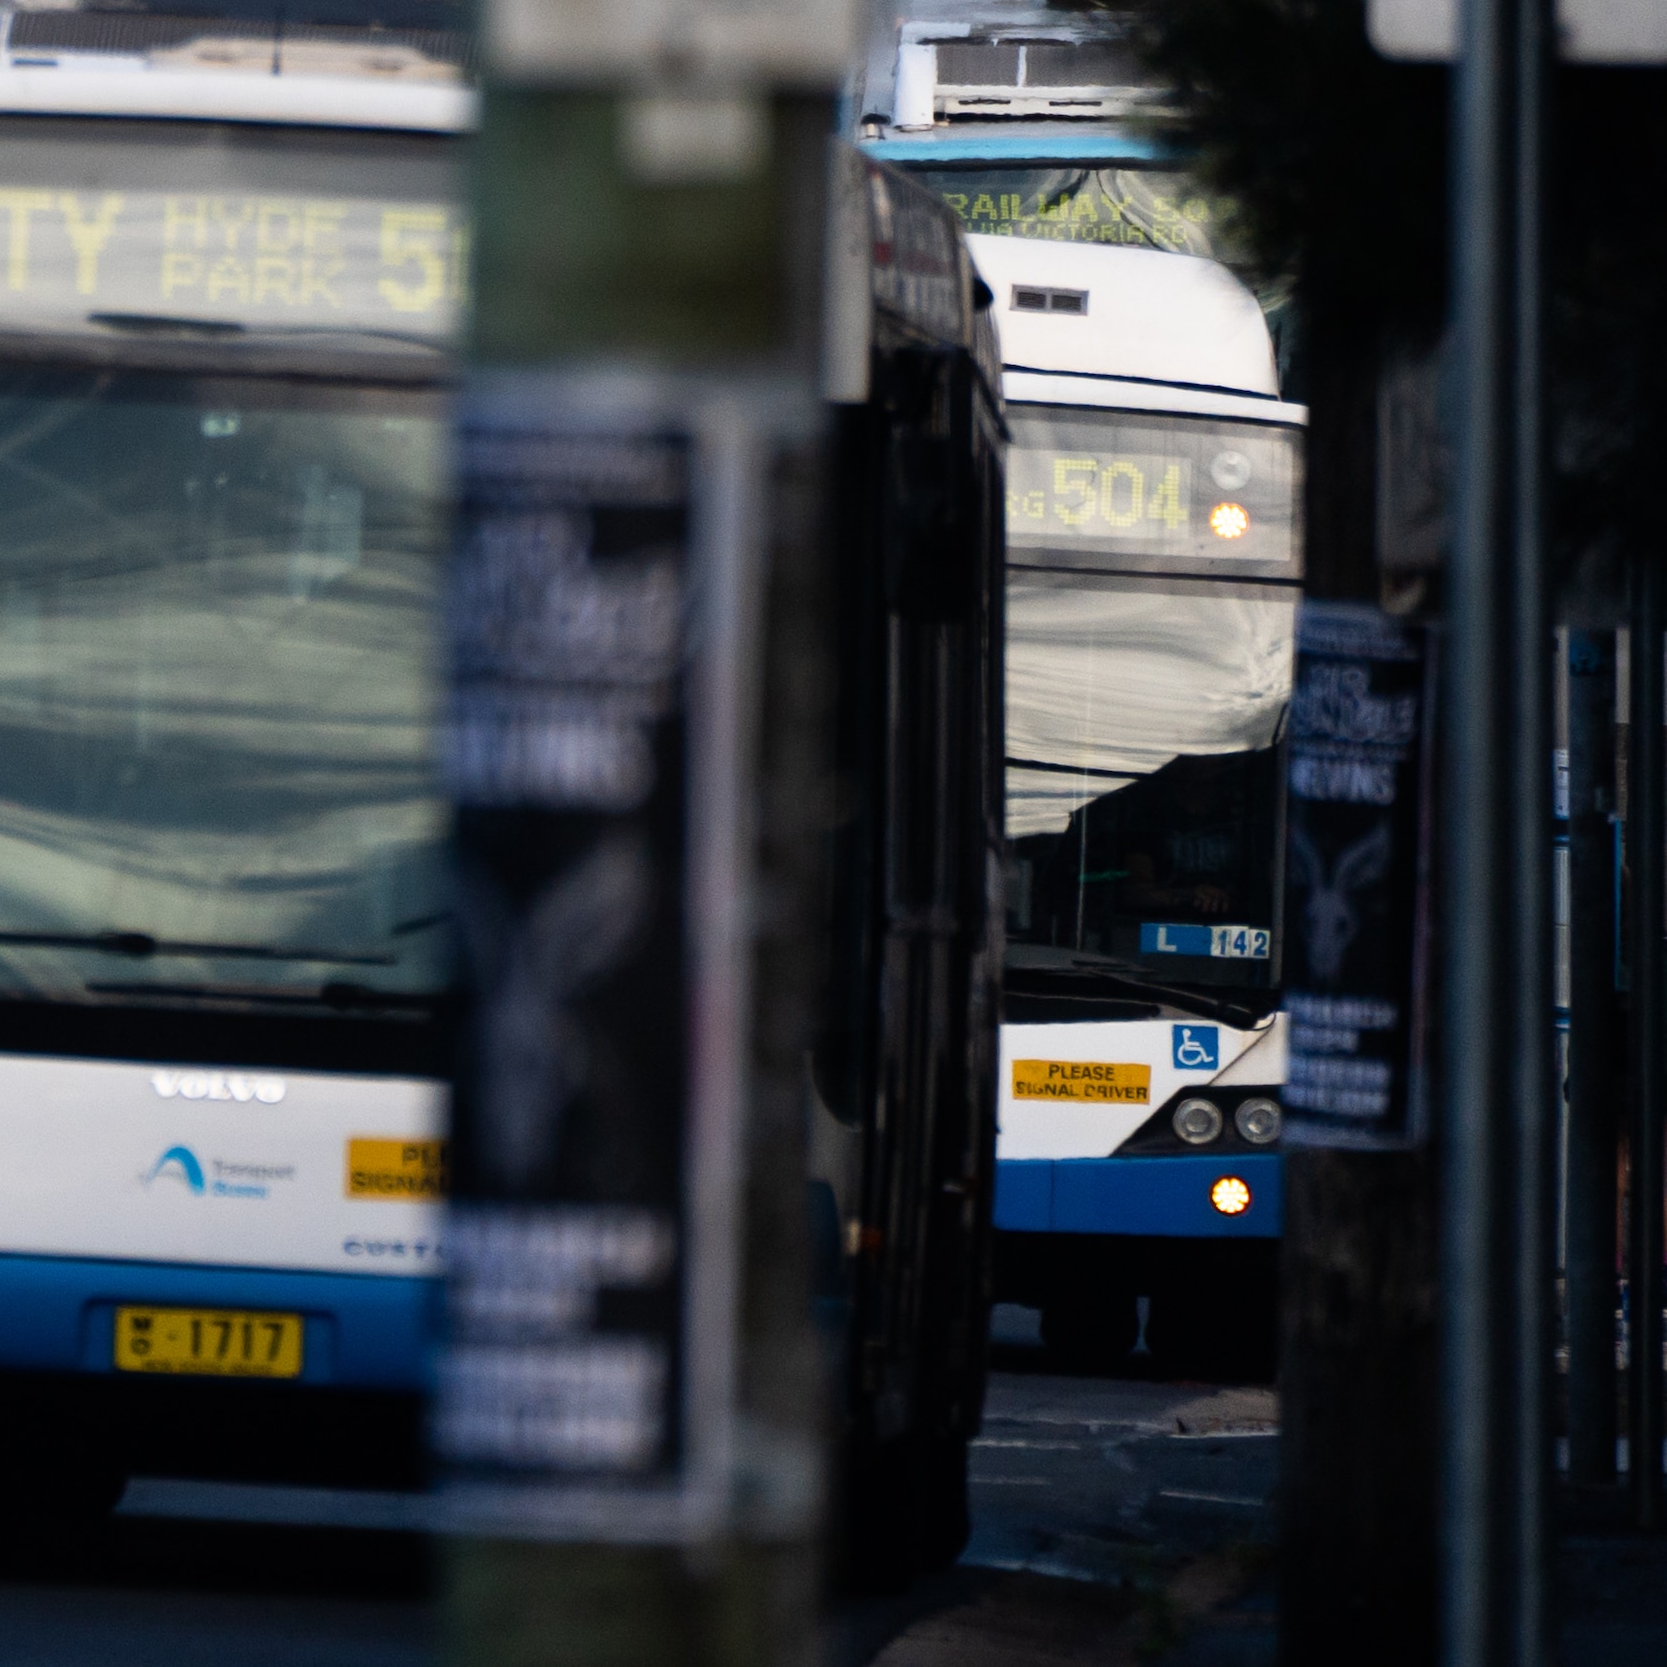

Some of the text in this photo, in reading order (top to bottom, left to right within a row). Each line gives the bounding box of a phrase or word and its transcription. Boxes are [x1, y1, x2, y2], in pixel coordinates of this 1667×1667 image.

[942, 192, 1134, 223] RAILWAY
[166, 194, 350, 255] HYDE
[1021, 222, 1145, 243] VICTORIA
[160, 250, 349, 309] PARK
[1053, 458, 1190, 530] 504
[1156, 927, 1268, 957] L 142
[151, 1070, 287, 1104] VOLVO
[1047, 1064, 1116, 1082] PLEASE
[1015, 1081, 1149, 1100] SIGNAL DRIVER
[190, 1318, 284, 1361] 1717
